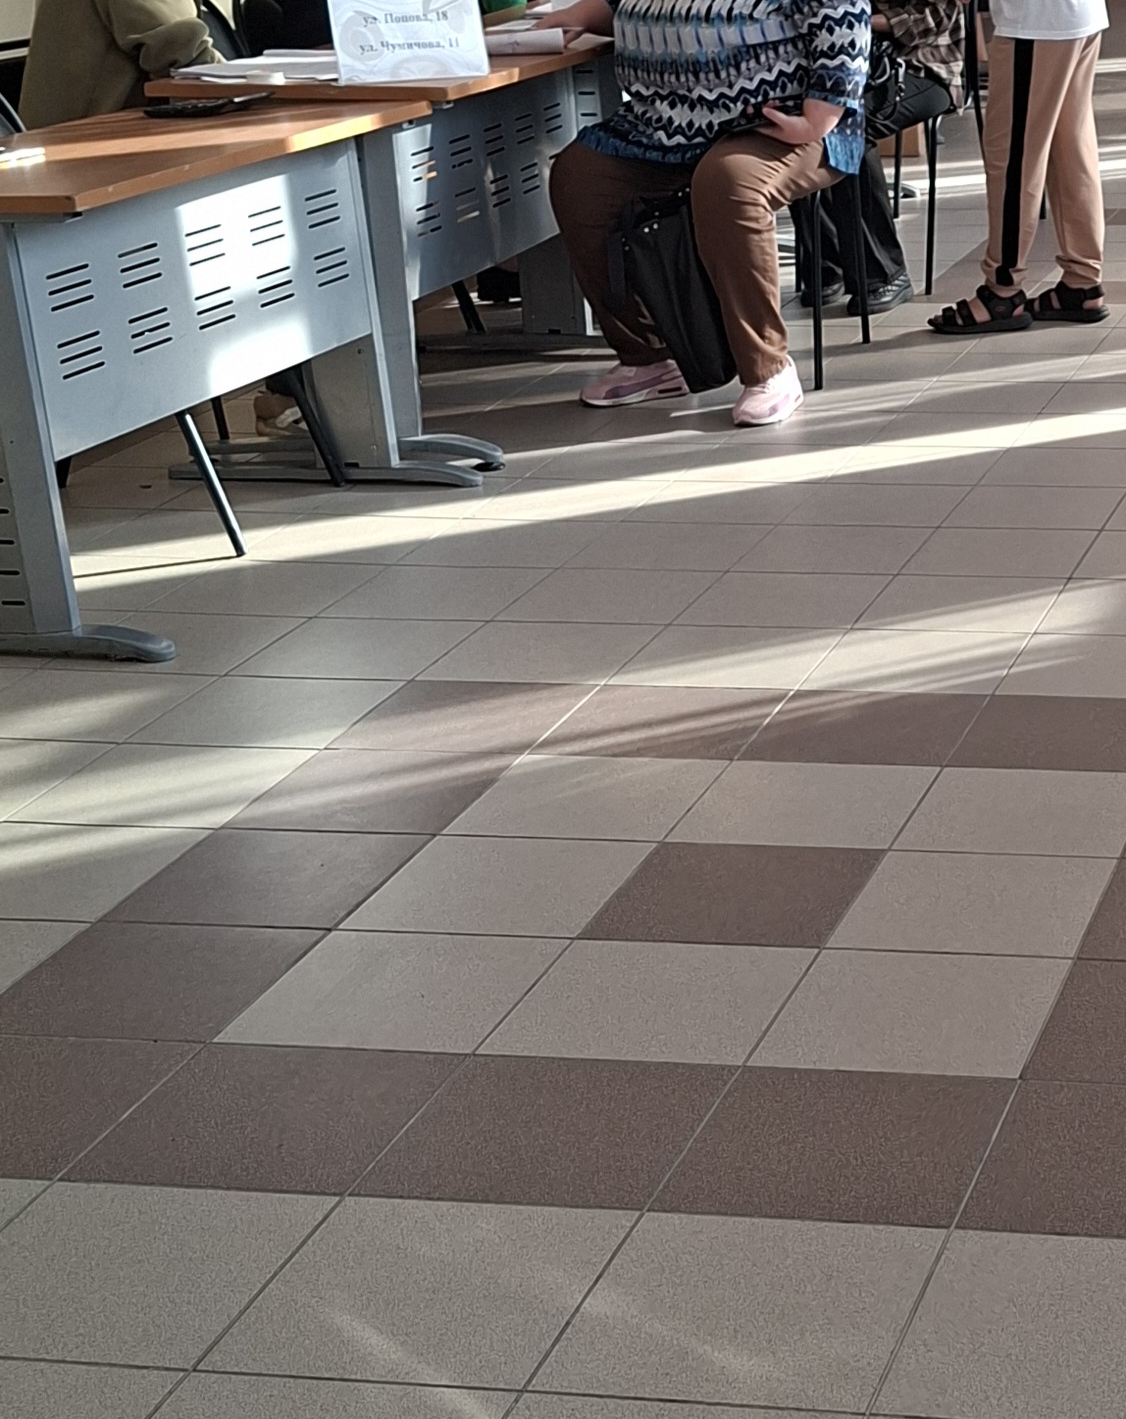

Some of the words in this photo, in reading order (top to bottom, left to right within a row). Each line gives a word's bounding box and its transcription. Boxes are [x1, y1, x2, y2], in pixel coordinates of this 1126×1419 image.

[435, 9, 449, 22] 18
[359, 44, 378, 55] ул.
[448, 36, 460, 48] 11
